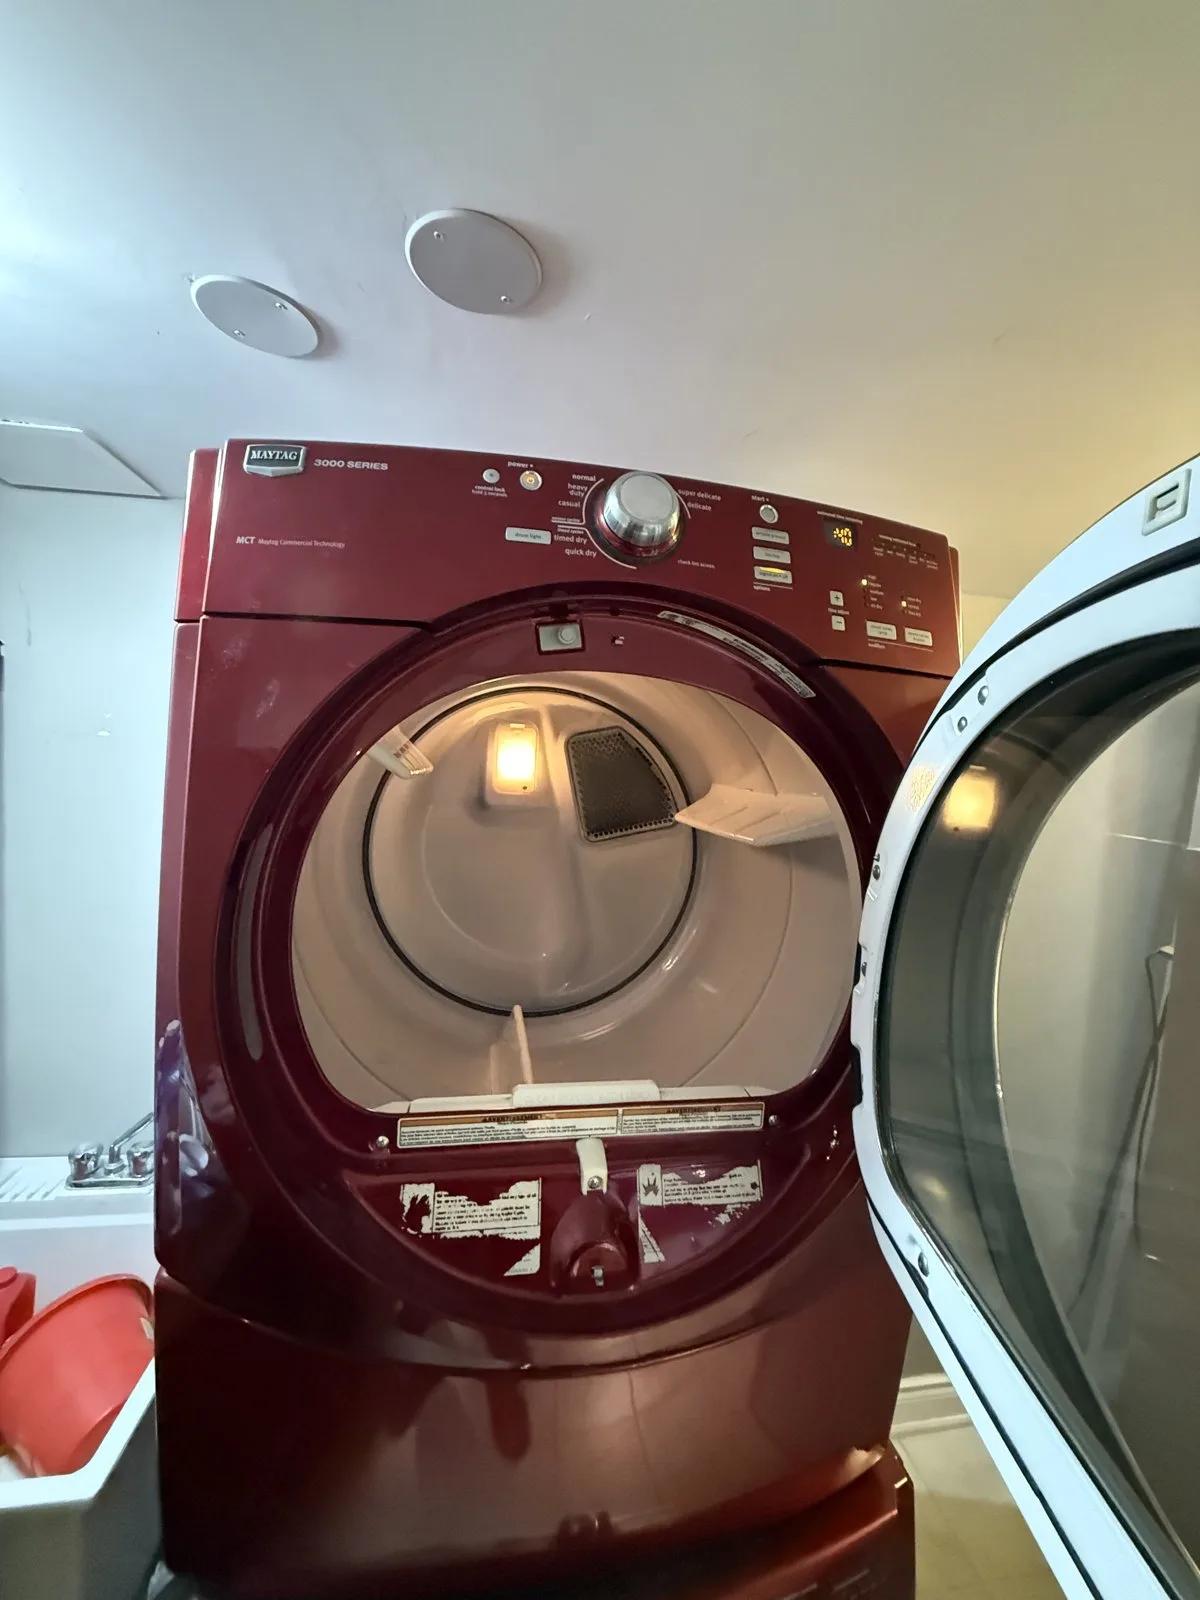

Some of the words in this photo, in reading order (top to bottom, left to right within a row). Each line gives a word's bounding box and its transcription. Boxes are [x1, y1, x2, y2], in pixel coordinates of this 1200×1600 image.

[250, 450, 298, 461] MAYTAG
[314, 459, 345, 467] 3000
[347, 460, 388, 470] SERIES
[572, 474, 596, 482] normal
[568, 483, 588, 492] heavy
[570, 490, 585, 498] duty
[678, 489, 695, 497] super
[697, 491, 721, 501] delicate
[558, 499, 581, 507] casual
[687, 502, 711, 511] delicate
[236, 536, 255, 544] MCT
[258, 538, 279, 546] Maytag
[313, 540, 345, 548] Technology
[554, 534, 574, 543] timed
[576, 536, 588, 545] dry
[565, 548, 584, 556] quick
[585, 549, 597, 558] dry
